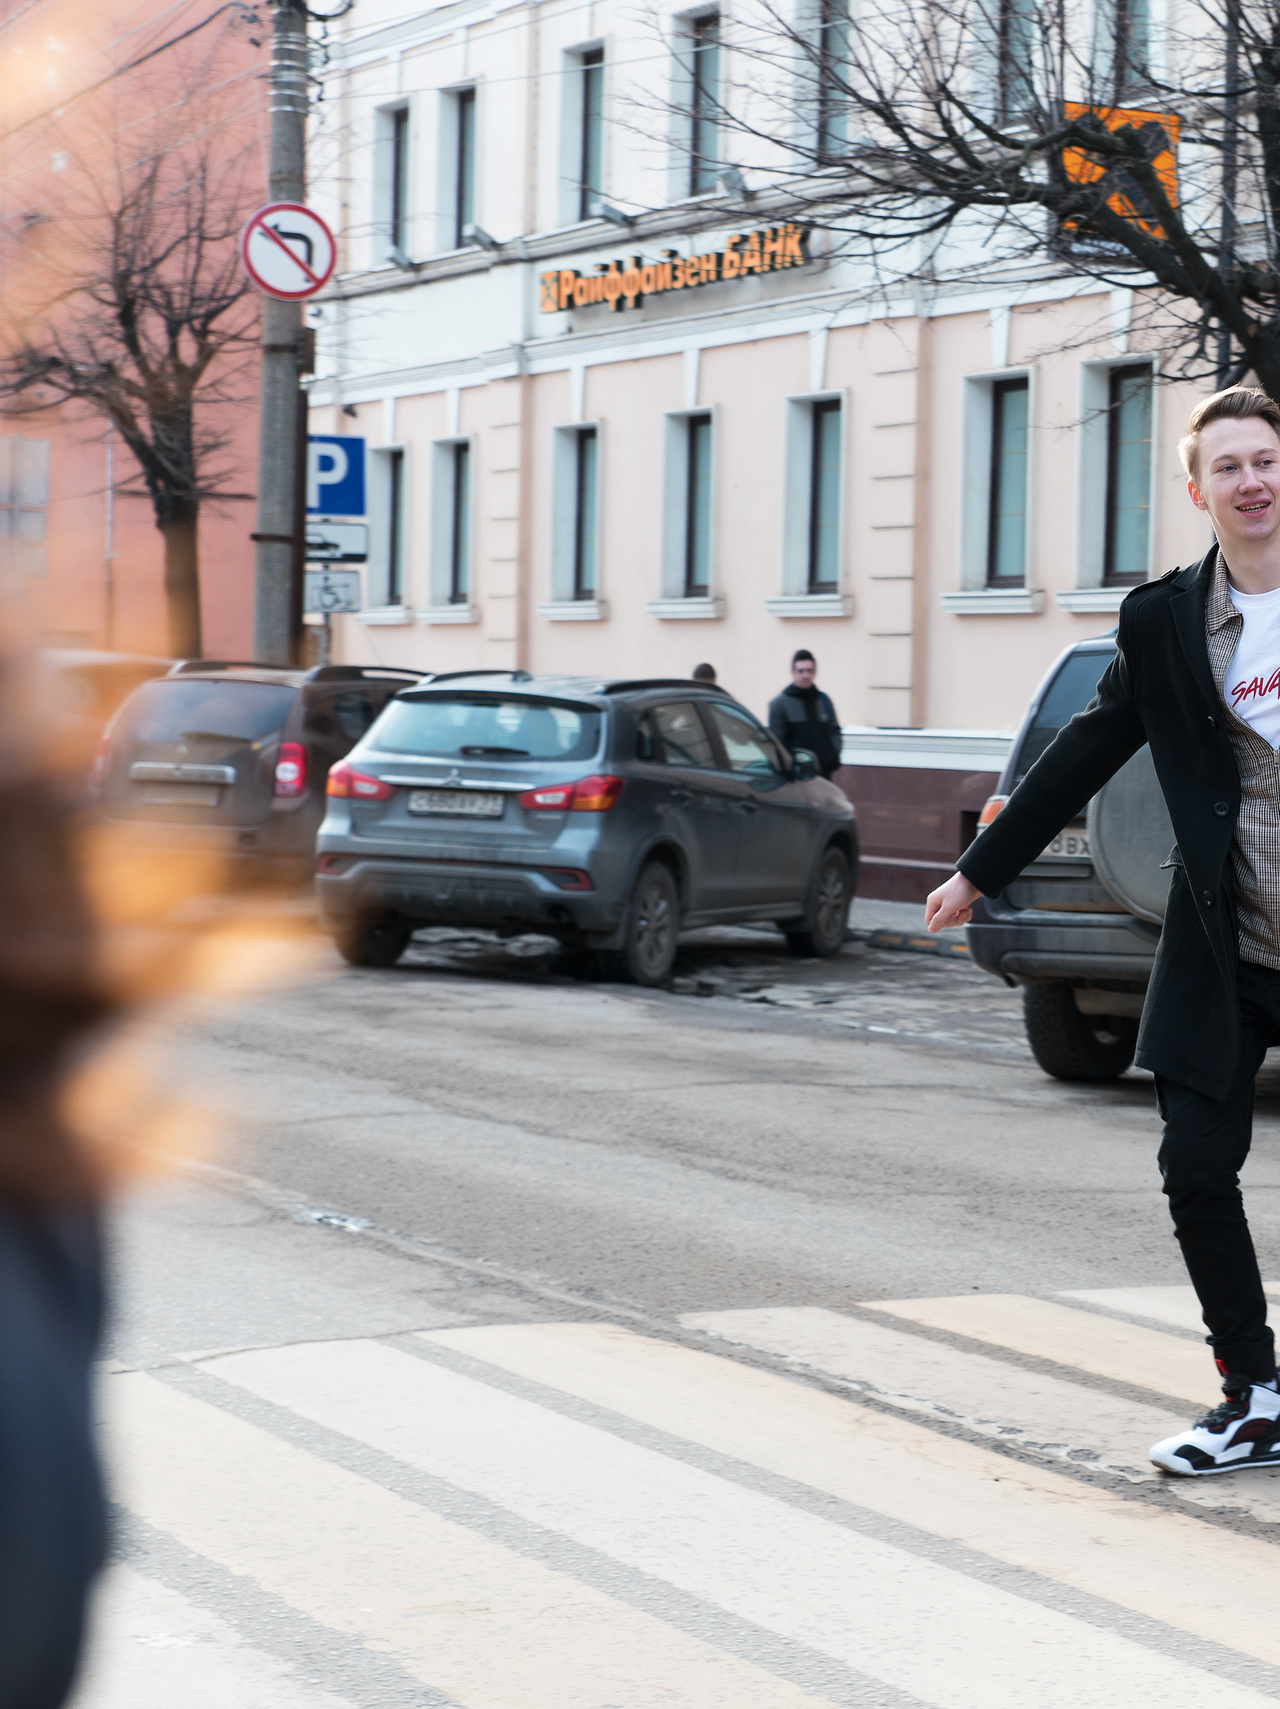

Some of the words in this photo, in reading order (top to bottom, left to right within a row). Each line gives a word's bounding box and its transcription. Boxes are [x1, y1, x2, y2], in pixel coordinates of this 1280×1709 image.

[559, 249, 717, 312] Райффайзен
[721, 222, 804, 279] БАНК
[307, 442, 348, 509] P
